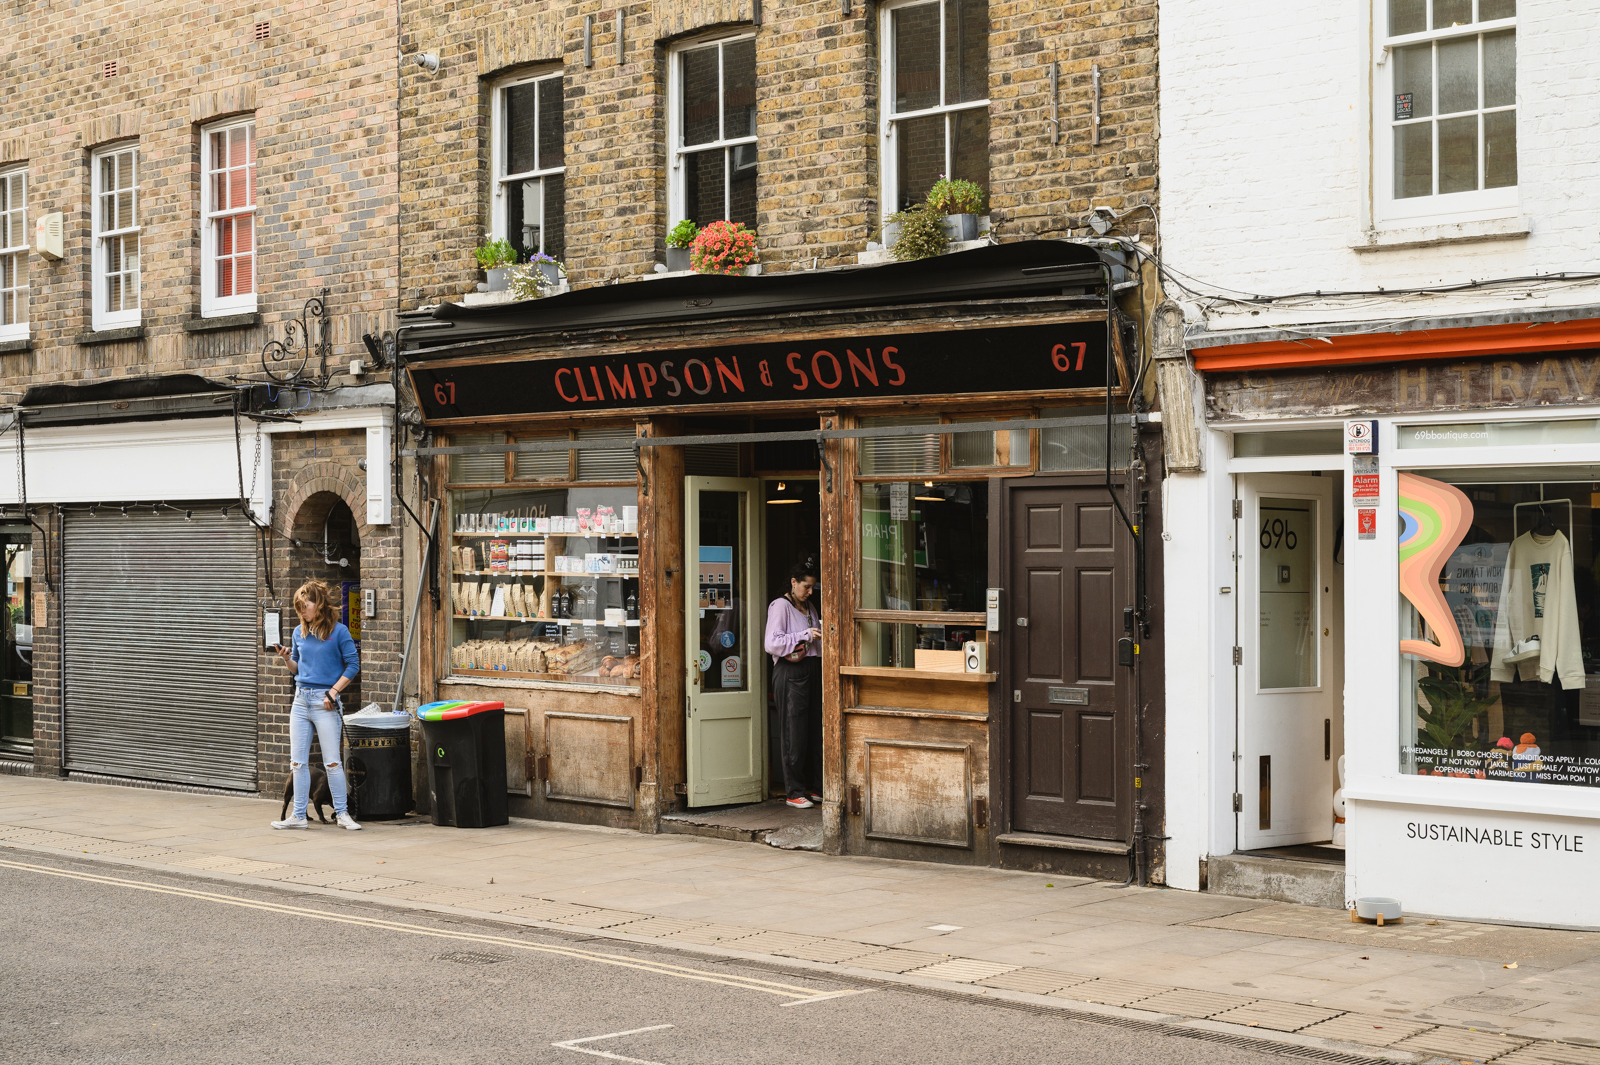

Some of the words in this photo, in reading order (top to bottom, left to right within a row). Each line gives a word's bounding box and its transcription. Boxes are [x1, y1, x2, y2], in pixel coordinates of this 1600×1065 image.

[1051, 341, 1087, 372] 67
[554, 356, 745, 403] CLIMPSON
[759, 359, 773, 387] &
[786, 346, 906, 391] SONS
[434, 382, 456, 405] 67
[1414, 430, 1489, 441] 69bboutique.com
[1354, 476, 1378, 484] Alarm
[1260, 518, 1298, 550] 69b
[359, 738, 397, 747] LITTER
[1402, 746, 1448, 756] ARMEDANGELS
[1456, 750, 1476, 758] BOBO
[1476, 751, 1503, 759] CHOSES
[1512, 754, 1554, 762] CONDITIONS
[1555, 756, 1575, 764] APPLY
[1415, 756, 1433, 764] HVISK
[1464, 759, 1481, 767] NOW
[1490, 760, 1509, 769] JAKKE
[1517, 762, 1531, 770] JUST
[1532, 764, 1557, 772] FEMALE
[1567, 765, 1600, 774] KOWTOW
[1434, 765, 1480, 775] COPENHAGEN
[1488, 770, 1526, 778] MARIMEKKO
[1535, 772, 1551, 780] MISS
[1552, 773, 1568, 781] POM
[1569, 775, 1586, 783] POM
[1406, 822, 1523, 848] SUSTAINABLE
[1530, 832, 1584, 853] STYLE
